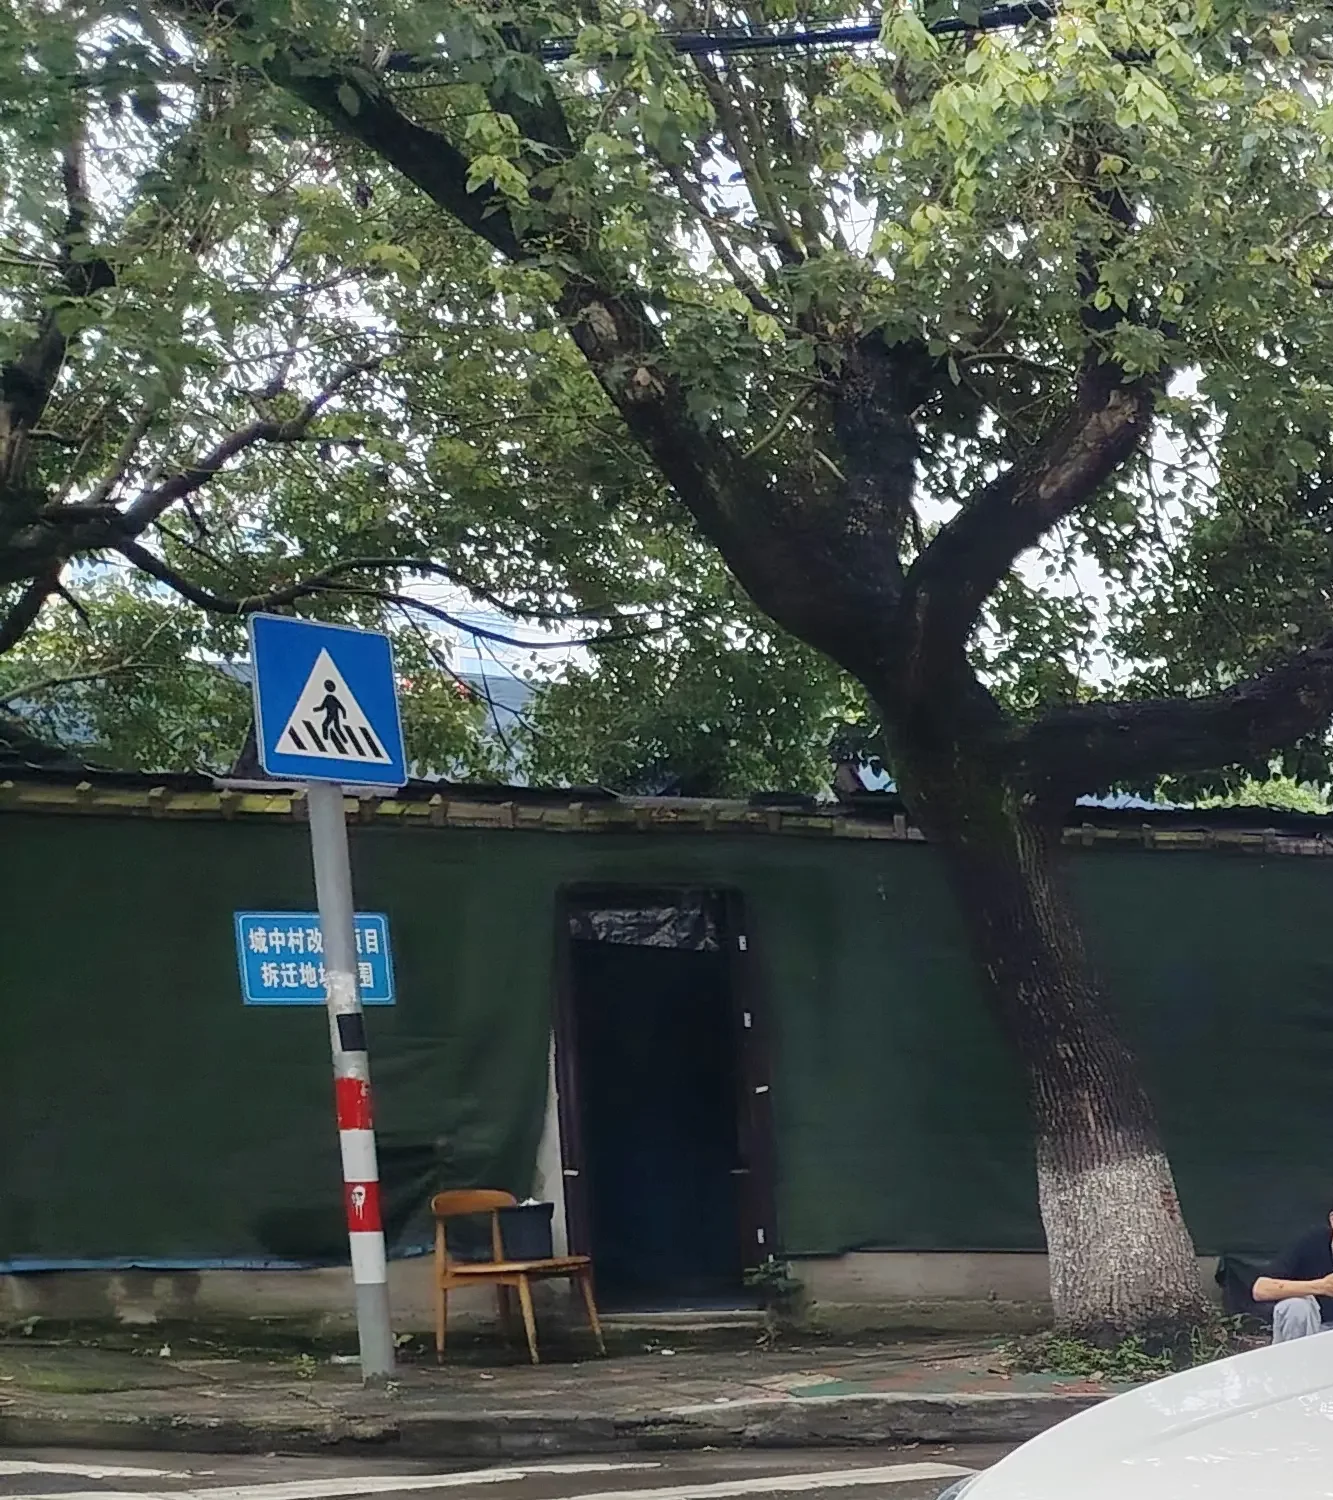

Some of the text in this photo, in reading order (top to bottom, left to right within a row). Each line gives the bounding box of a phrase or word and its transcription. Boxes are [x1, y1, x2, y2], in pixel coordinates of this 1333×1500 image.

[248, 927, 380, 954] 城中村改目
[260, 961, 375, 989] 拆迁地围
